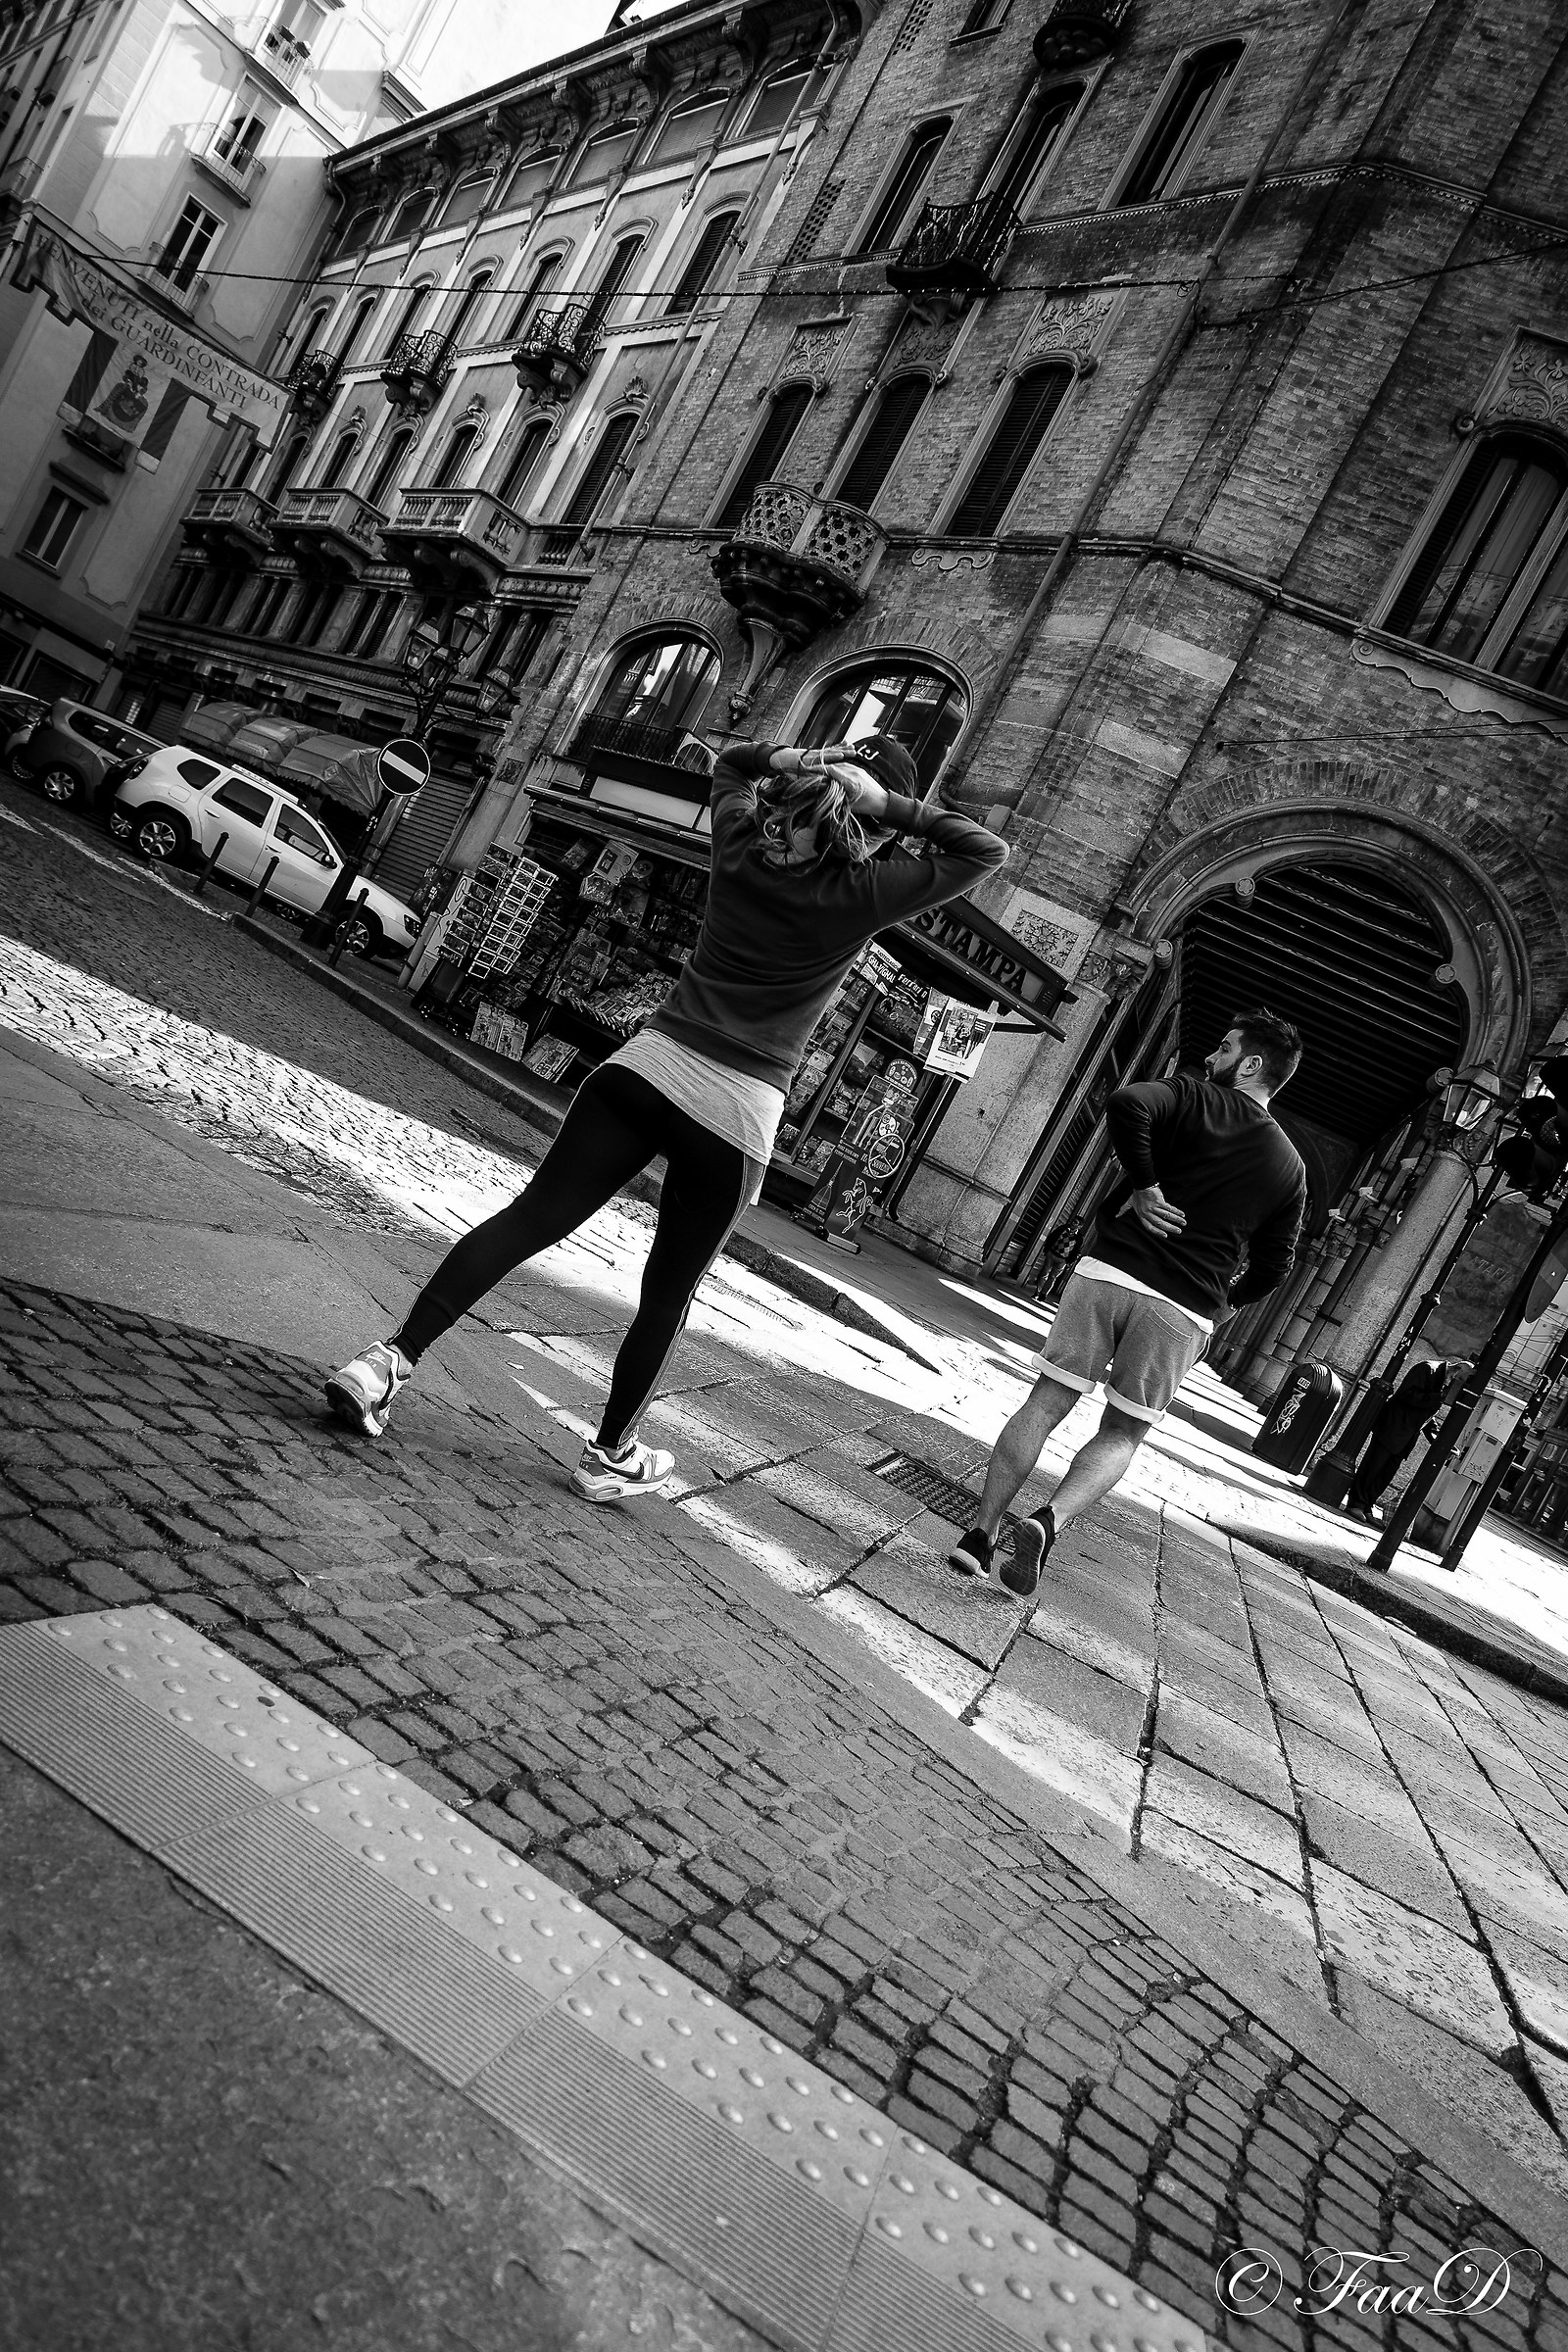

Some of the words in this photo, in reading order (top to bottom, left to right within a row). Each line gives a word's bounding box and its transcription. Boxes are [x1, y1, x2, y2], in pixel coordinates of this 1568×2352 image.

[36, 233, 140, 322] BENVENUTI
[143, 318, 180, 349] nella
[186, 344, 280, 411] CONTRADA
[81, 292, 108, 321] dei
[110, 316, 247, 410] GUARDINFANTI
[912, 907, 1025, 997] STAMPA
